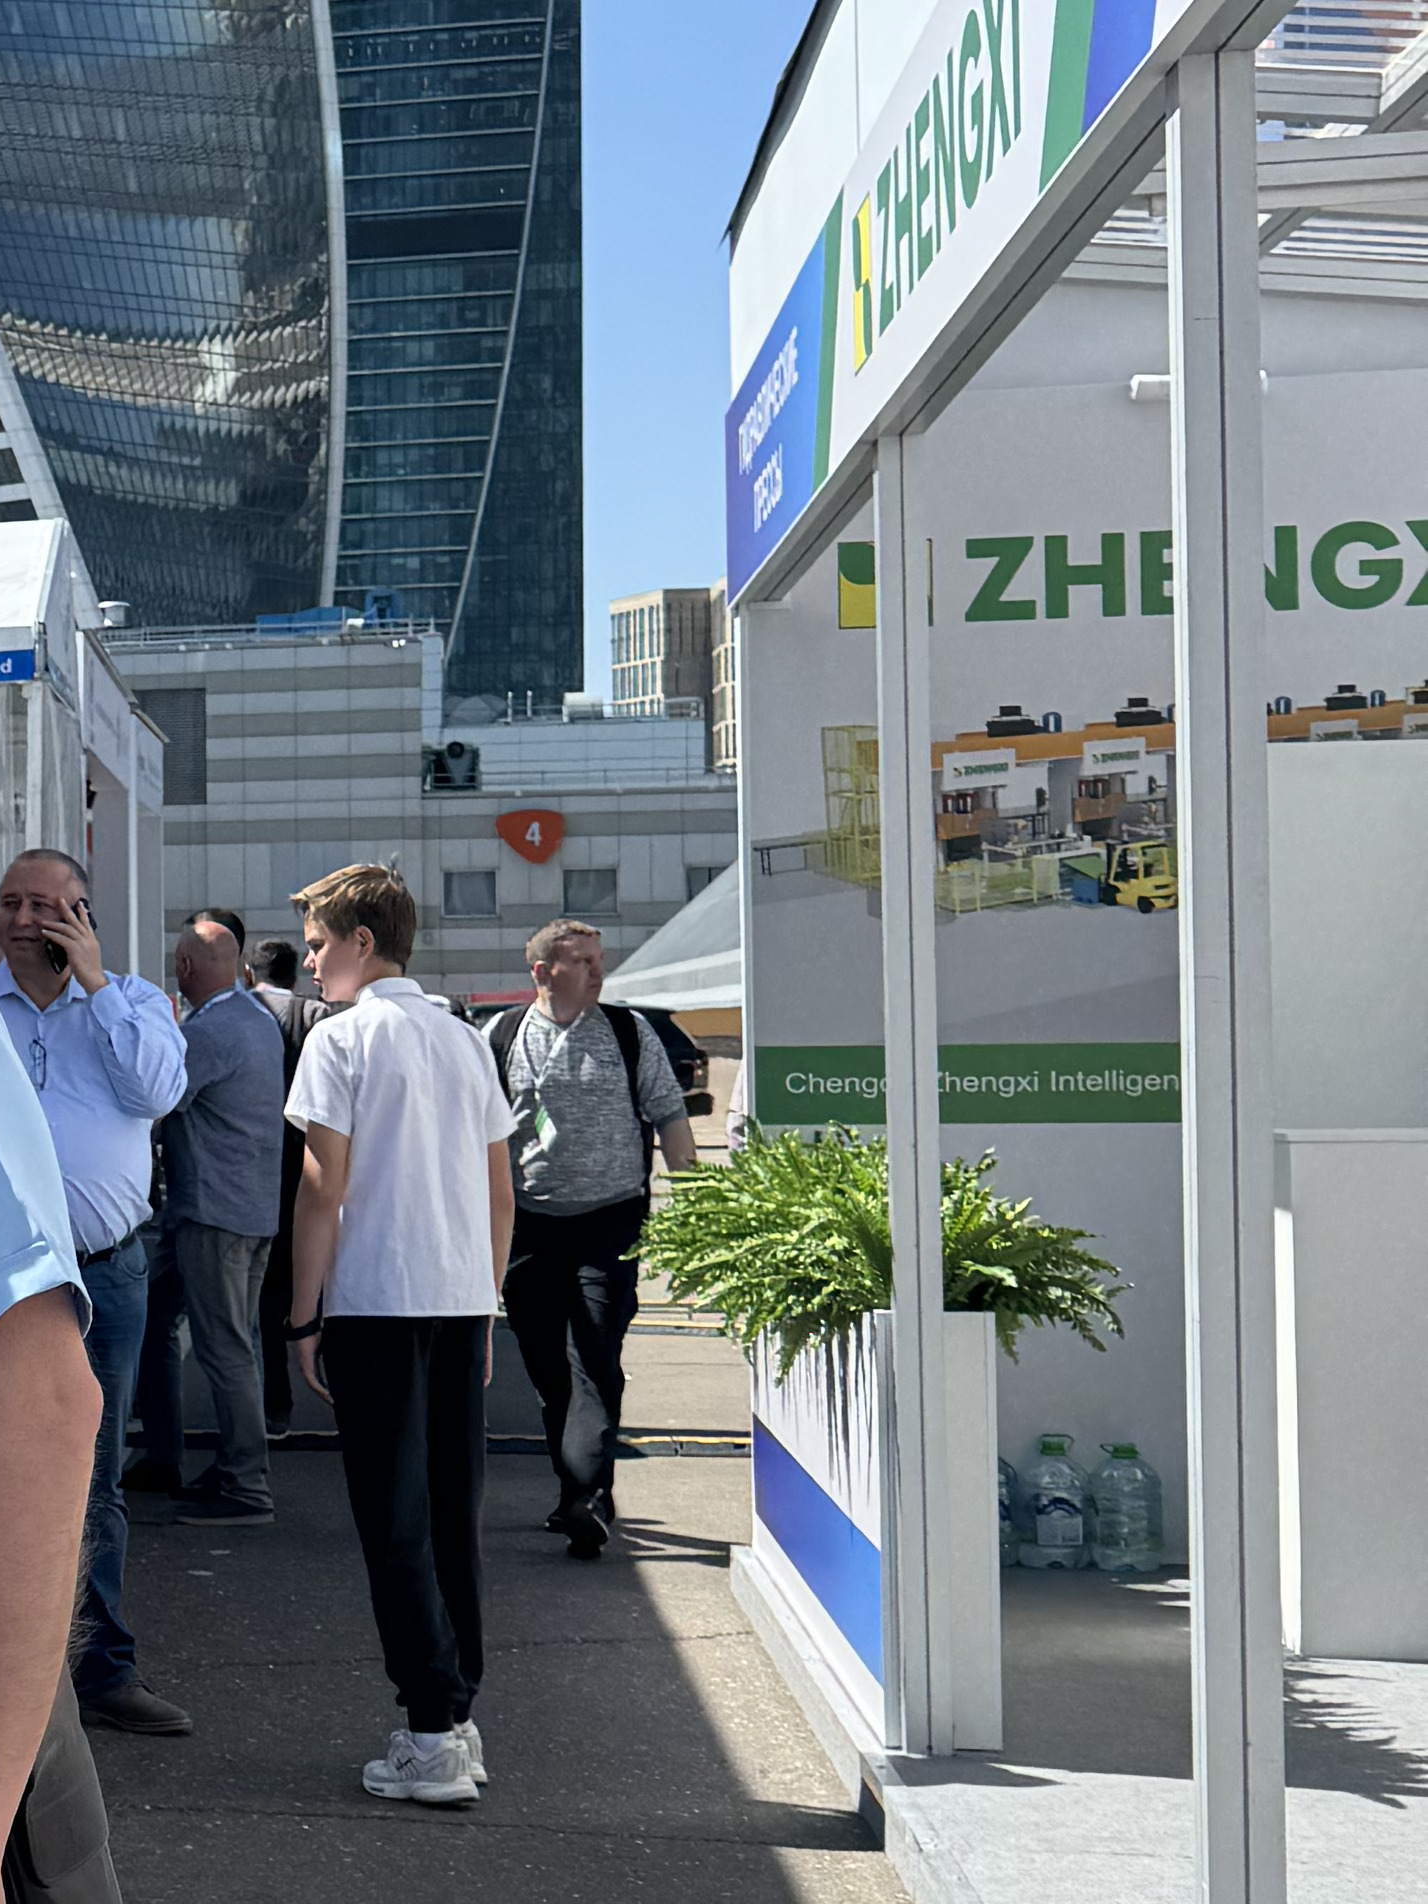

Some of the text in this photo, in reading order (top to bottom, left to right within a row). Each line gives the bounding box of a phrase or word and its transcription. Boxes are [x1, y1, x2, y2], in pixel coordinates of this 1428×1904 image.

[524, 821, 543, 847] 4
[785, 1071, 886, 1099] Cheng
[1050, 1067, 1178, 1097] Intelligen
